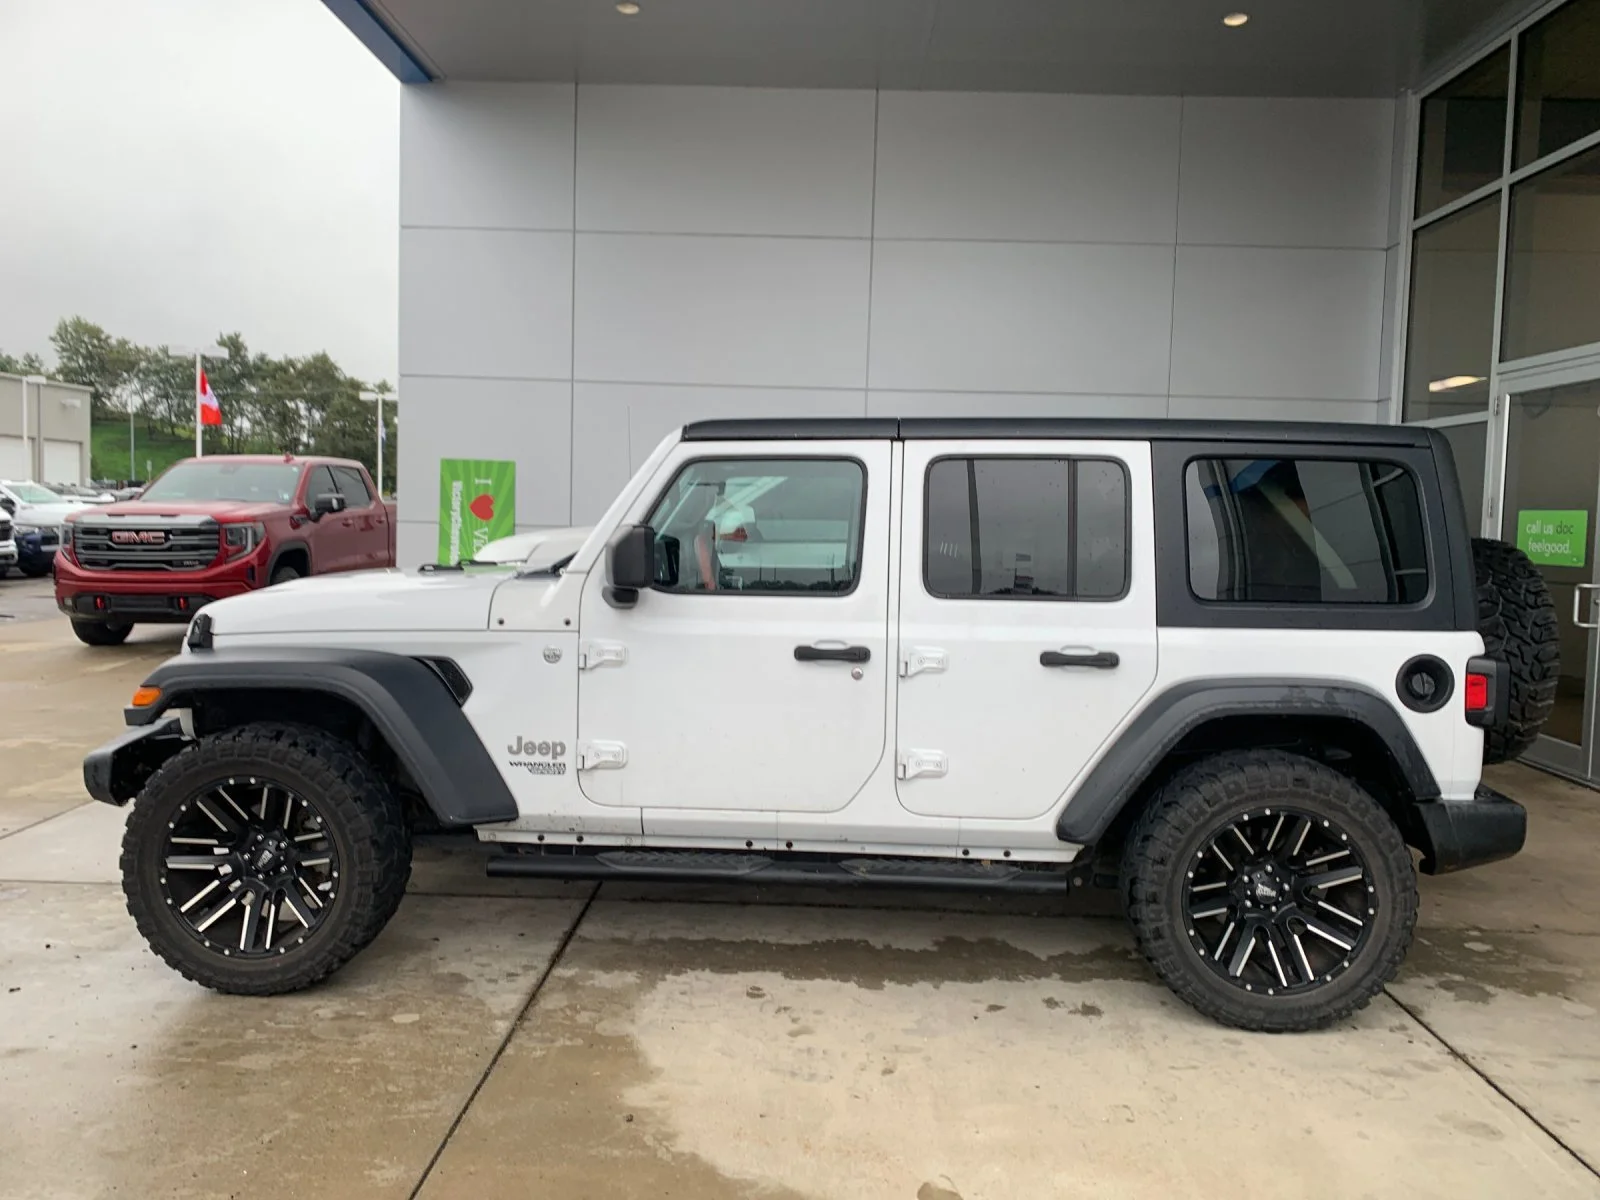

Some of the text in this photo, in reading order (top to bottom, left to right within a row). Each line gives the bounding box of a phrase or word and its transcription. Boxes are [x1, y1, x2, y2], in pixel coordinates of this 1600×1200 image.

[1526, 519, 1575, 536] call us doc
[112, 531, 165, 544] GMC
[1528, 537, 1572, 557] feelgood.
[507, 735, 567, 760] Jeep
[508, 760, 566, 769] WRANGLER
